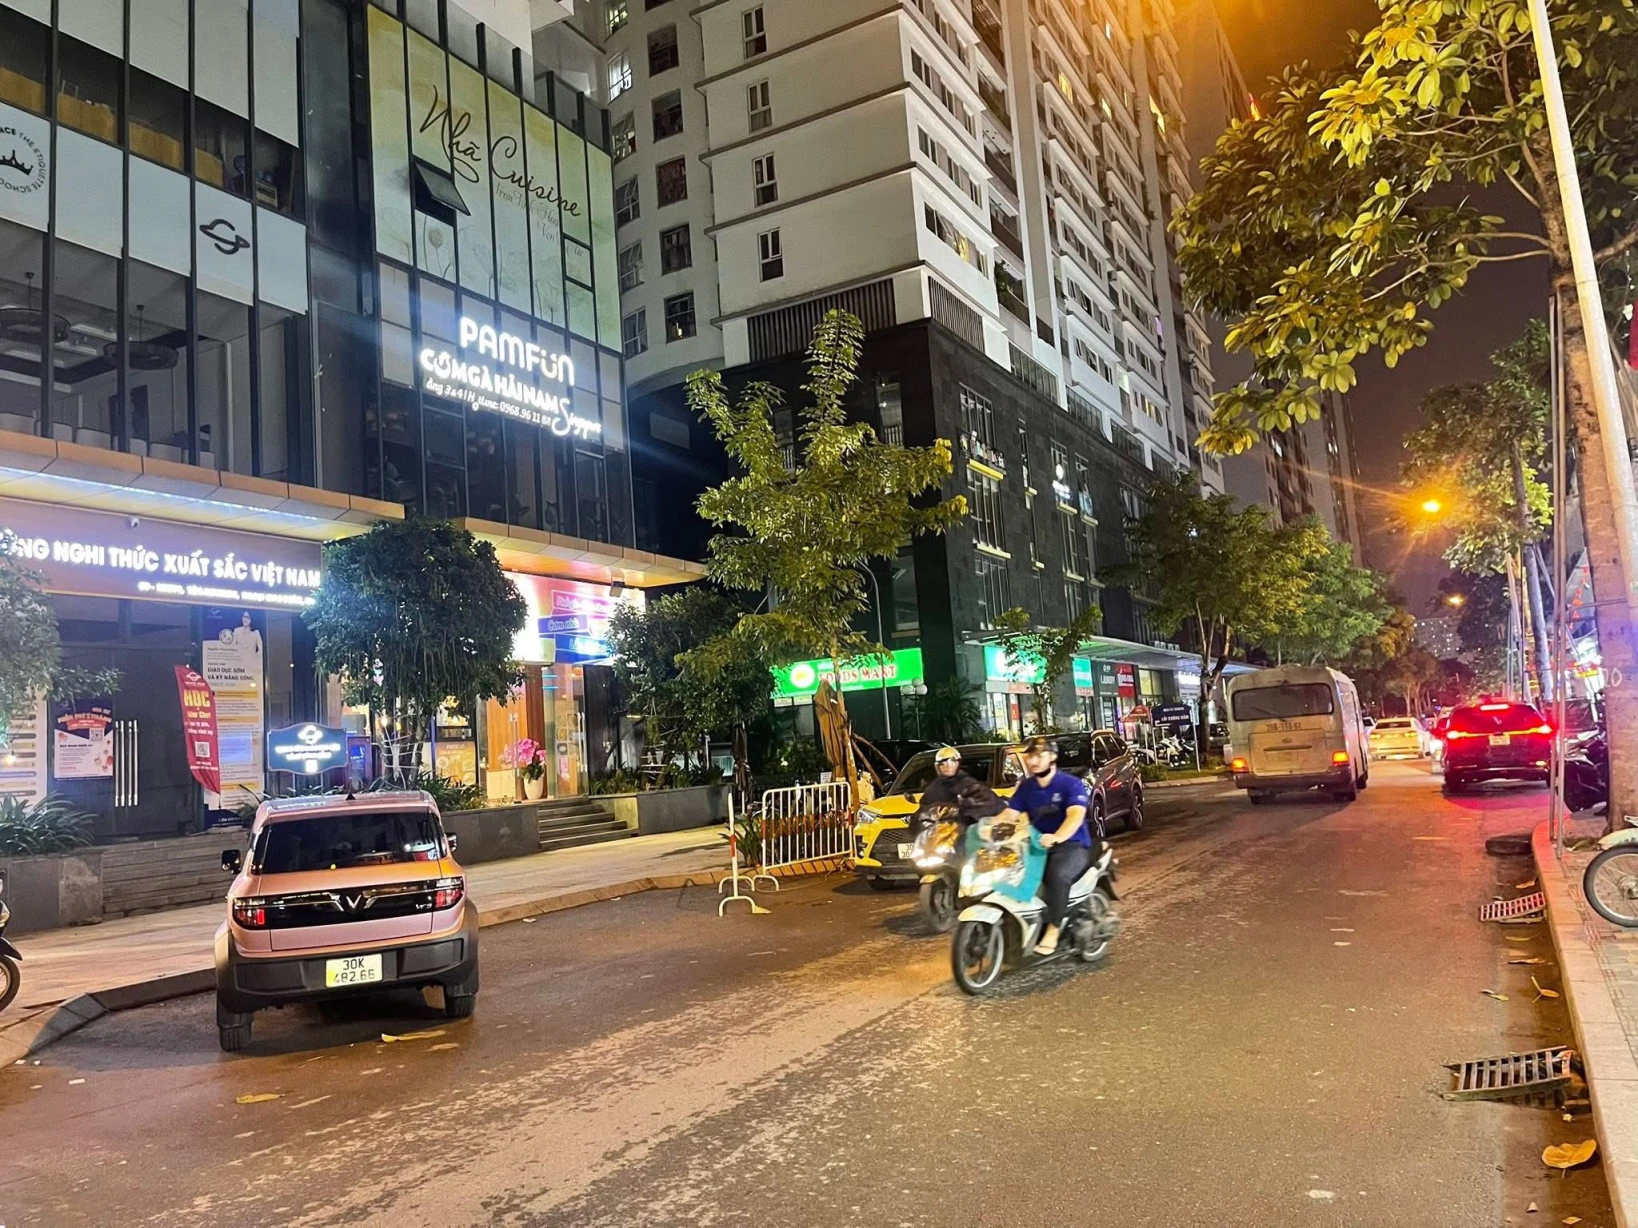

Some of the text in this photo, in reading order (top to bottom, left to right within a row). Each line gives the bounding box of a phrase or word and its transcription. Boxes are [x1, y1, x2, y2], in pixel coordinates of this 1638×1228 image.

[20, 132, 35, 147] THE
[419, 84, 581, 216] Nhã Cuisine
[53, 541, 104, 566] NGHI
[109, 544, 159, 572] THỨC
[164, 550, 210, 577] XUẤT
[213, 552, 248, 581] SẮC
[251, 561, 284, 587] VIỆT
[286, 567, 321, 588] NAM
[820, 671, 858, 682] FODS
[343, 958, 364, 970] 30K
[333, 969, 375, 983] 482.66
